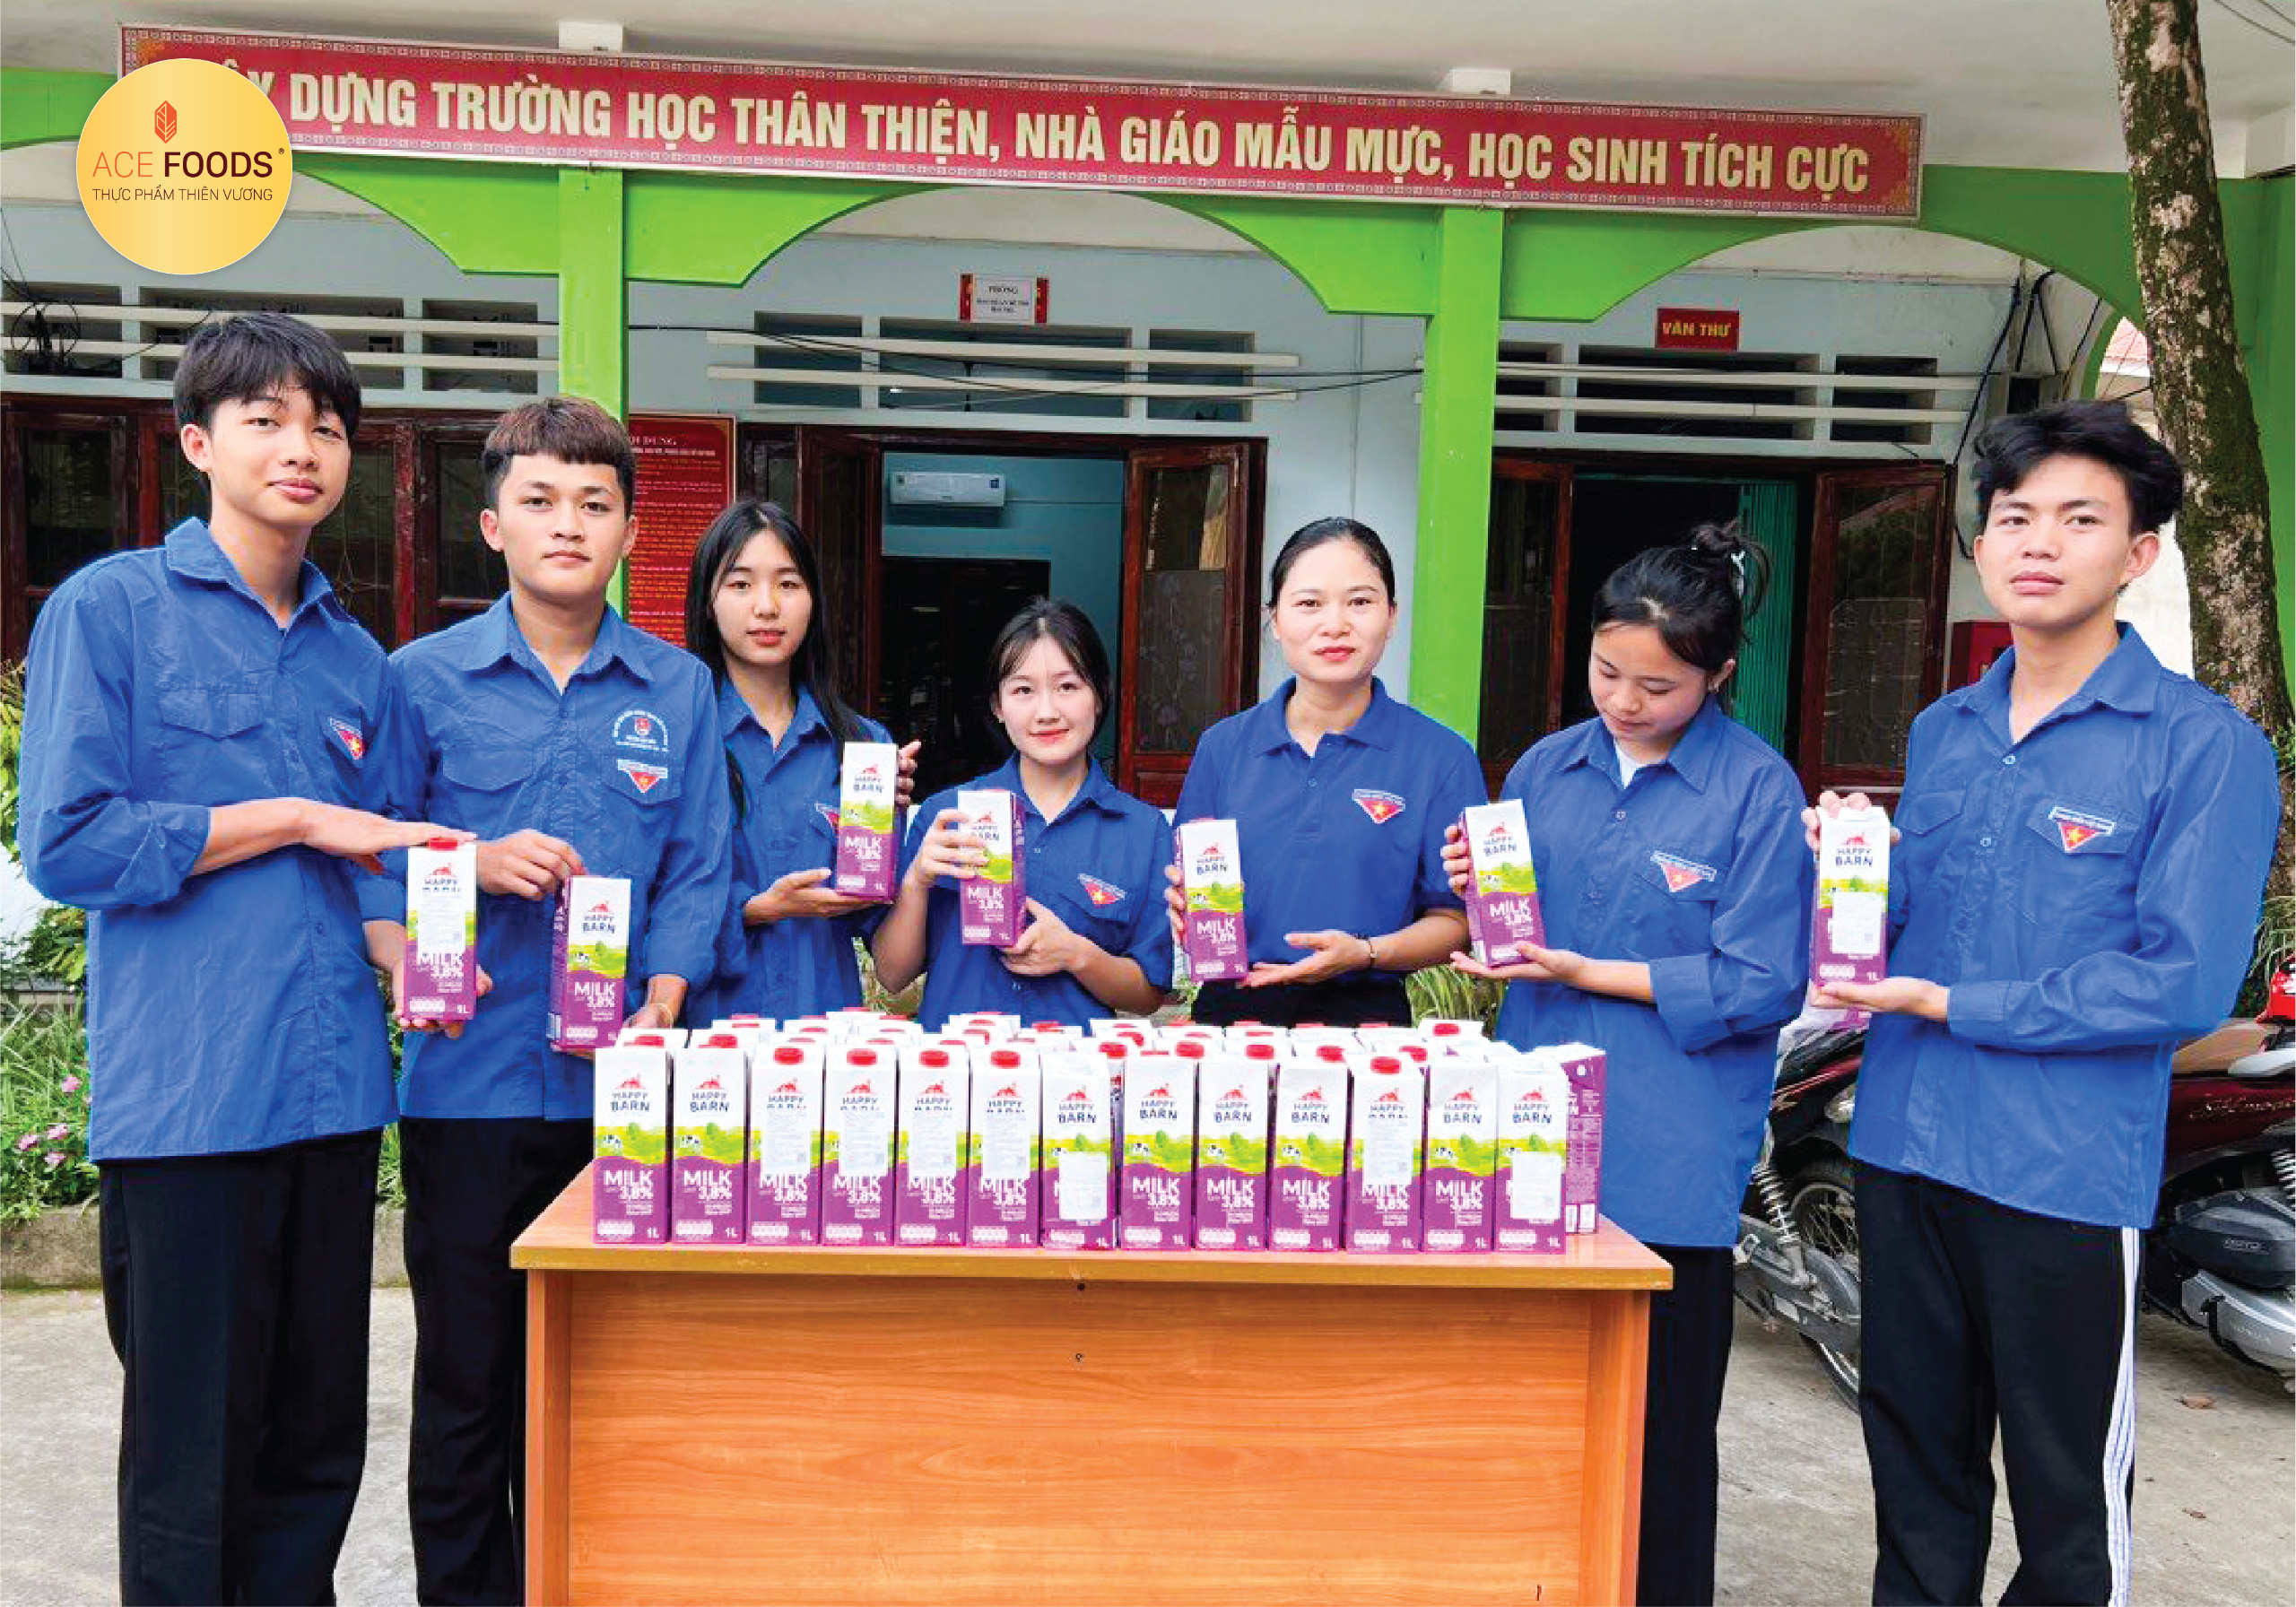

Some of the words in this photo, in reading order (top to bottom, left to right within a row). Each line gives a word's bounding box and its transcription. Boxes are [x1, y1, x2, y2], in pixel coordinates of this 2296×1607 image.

[291, 72, 416, 134] DỰNG
[430, 74, 611, 137] TRƯỜNG
[627, 91, 716, 151] HỌC
[731, 90, 846, 149] THÂN
[861, 98, 1000, 165] THIỆN,
[1016, 106, 1105, 161] NHÀ
[1120, 109, 1220, 166] GIÁO
[1235, 106, 1332, 171] MẪU
[1346, 125, 1454, 184] MỰC,
[1468, 133, 1552, 189] HỌC
[1566, 137, 1667, 186] SINH
[1681, 133, 1773, 190] TÍCH
[1786, 143, 1870, 202] CỰC
[1662, 320, 1695, 336] VĂN
[1835, 856, 1874, 867] BARN
[575, 981, 615, 996] MILK
[610, 1101, 650, 1113] BARN
[690, 1101, 730, 1113] BARN
[1057, 1112, 1097, 1124] BARN
[1139, 1109, 1178, 1120] BARN
[1213, 1111, 1252, 1123] BARN
[1291, 1112, 1330, 1124] BARN
[1443, 1113, 1483, 1124] BARN
[1512, 1113, 1552, 1124] BARN
[604, 1169, 654, 1186] MILK
[683, 1169, 733, 1186] MILK
[1132, 1177, 1181, 1194] MILK
[1206, 1177, 1256, 1194] MILK
[1283, 1178, 1332, 1195] MILK
[1436, 1179, 1483, 1196] MILK
